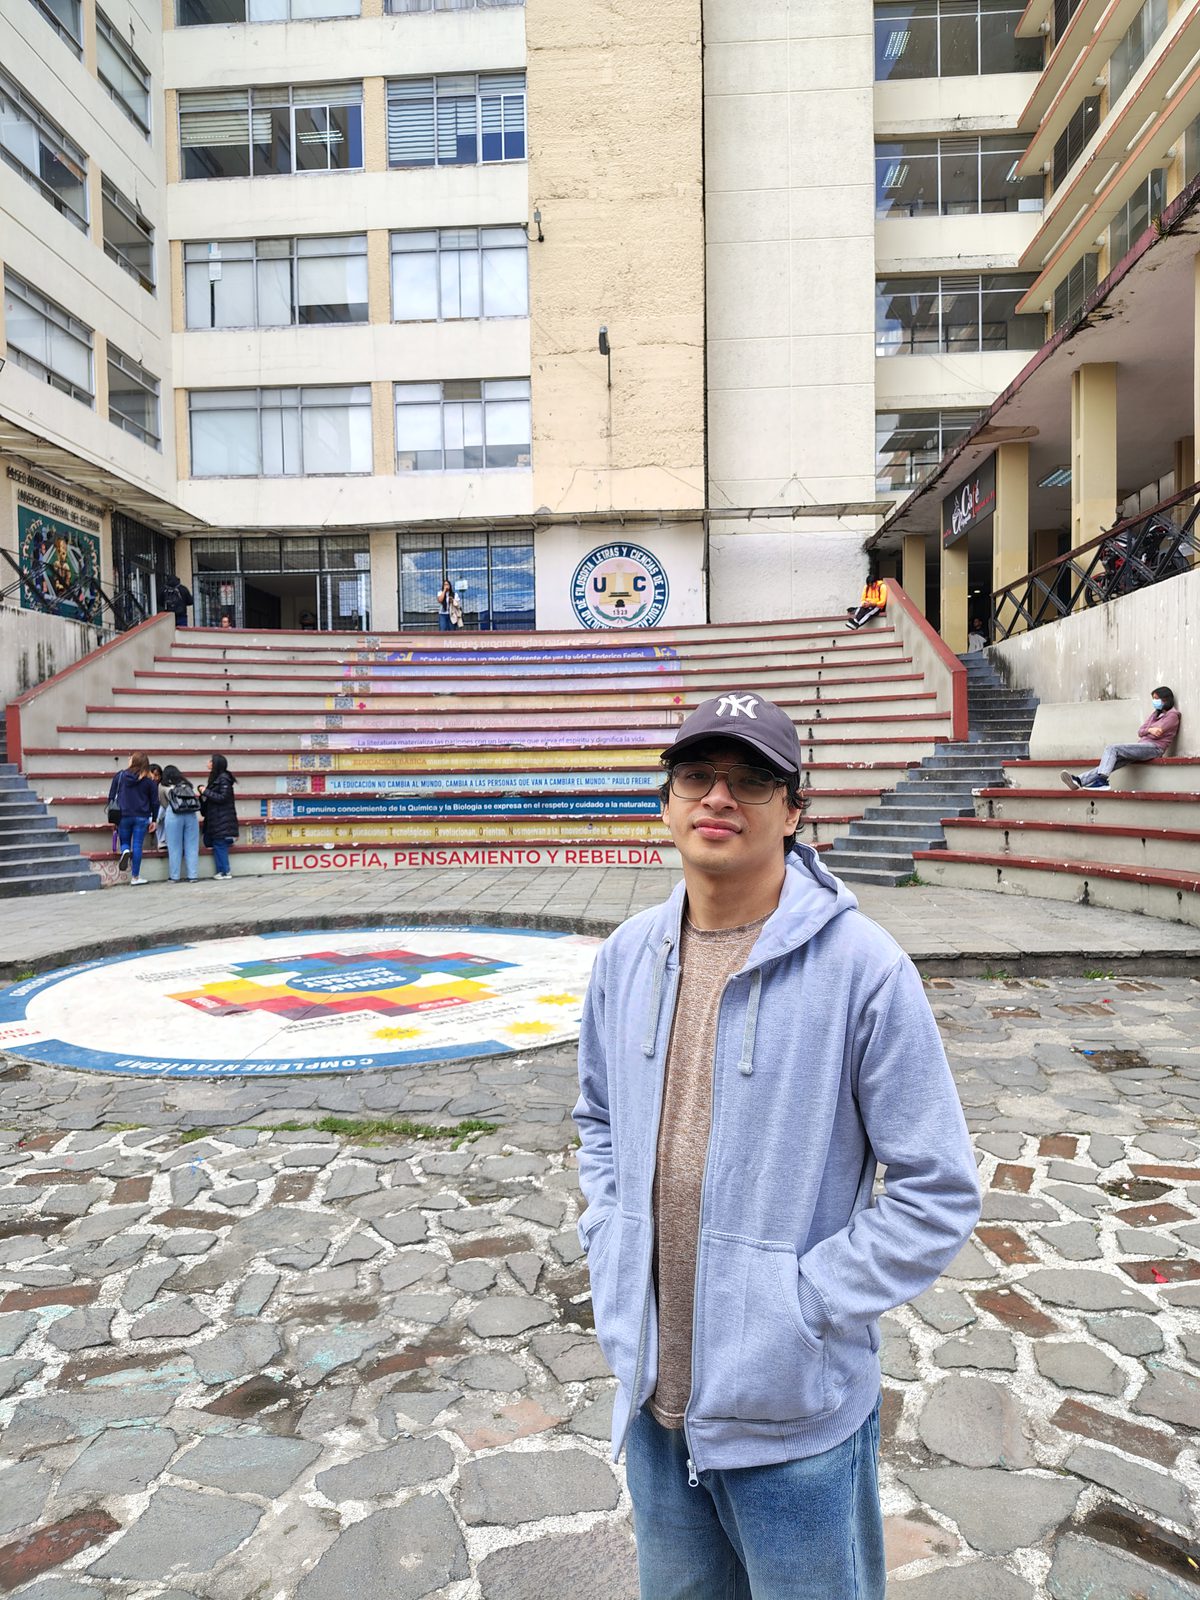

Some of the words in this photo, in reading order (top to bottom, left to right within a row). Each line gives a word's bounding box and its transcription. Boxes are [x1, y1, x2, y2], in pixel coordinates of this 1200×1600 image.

[592, 547, 620, 564] LETRAS
[622, 546, 628, 556] Y
[630, 548, 658, 575] CIENCIAS
[593, 577, 606, 592] U
[633, 576, 646, 592] C
[653, 574, 664, 586] DE
[654, 589, 664, 600] LA
[575, 599, 586, 610] DE
[443, 640, 478, 649] Mentes
[716, 694, 759, 719] NY
[398, 738, 434, 746] materializa
[343, 780, 376, 788] EDUCACIÓN
[420, 780, 444, 788] MUNDO,
[488, 779, 517, 787] PERSONAS
[550, 778, 575, 786] CAMBIAR
[306, 806, 336, 814] genuino
[408, 804, 438, 812] Química
[272, 850, 388, 870] FILOSOFÍA,
[394, 850, 541, 866] PENSAMIENTO
[546, 850, 559, 864] Y
[565, 846, 663, 864] REBELDÍA
